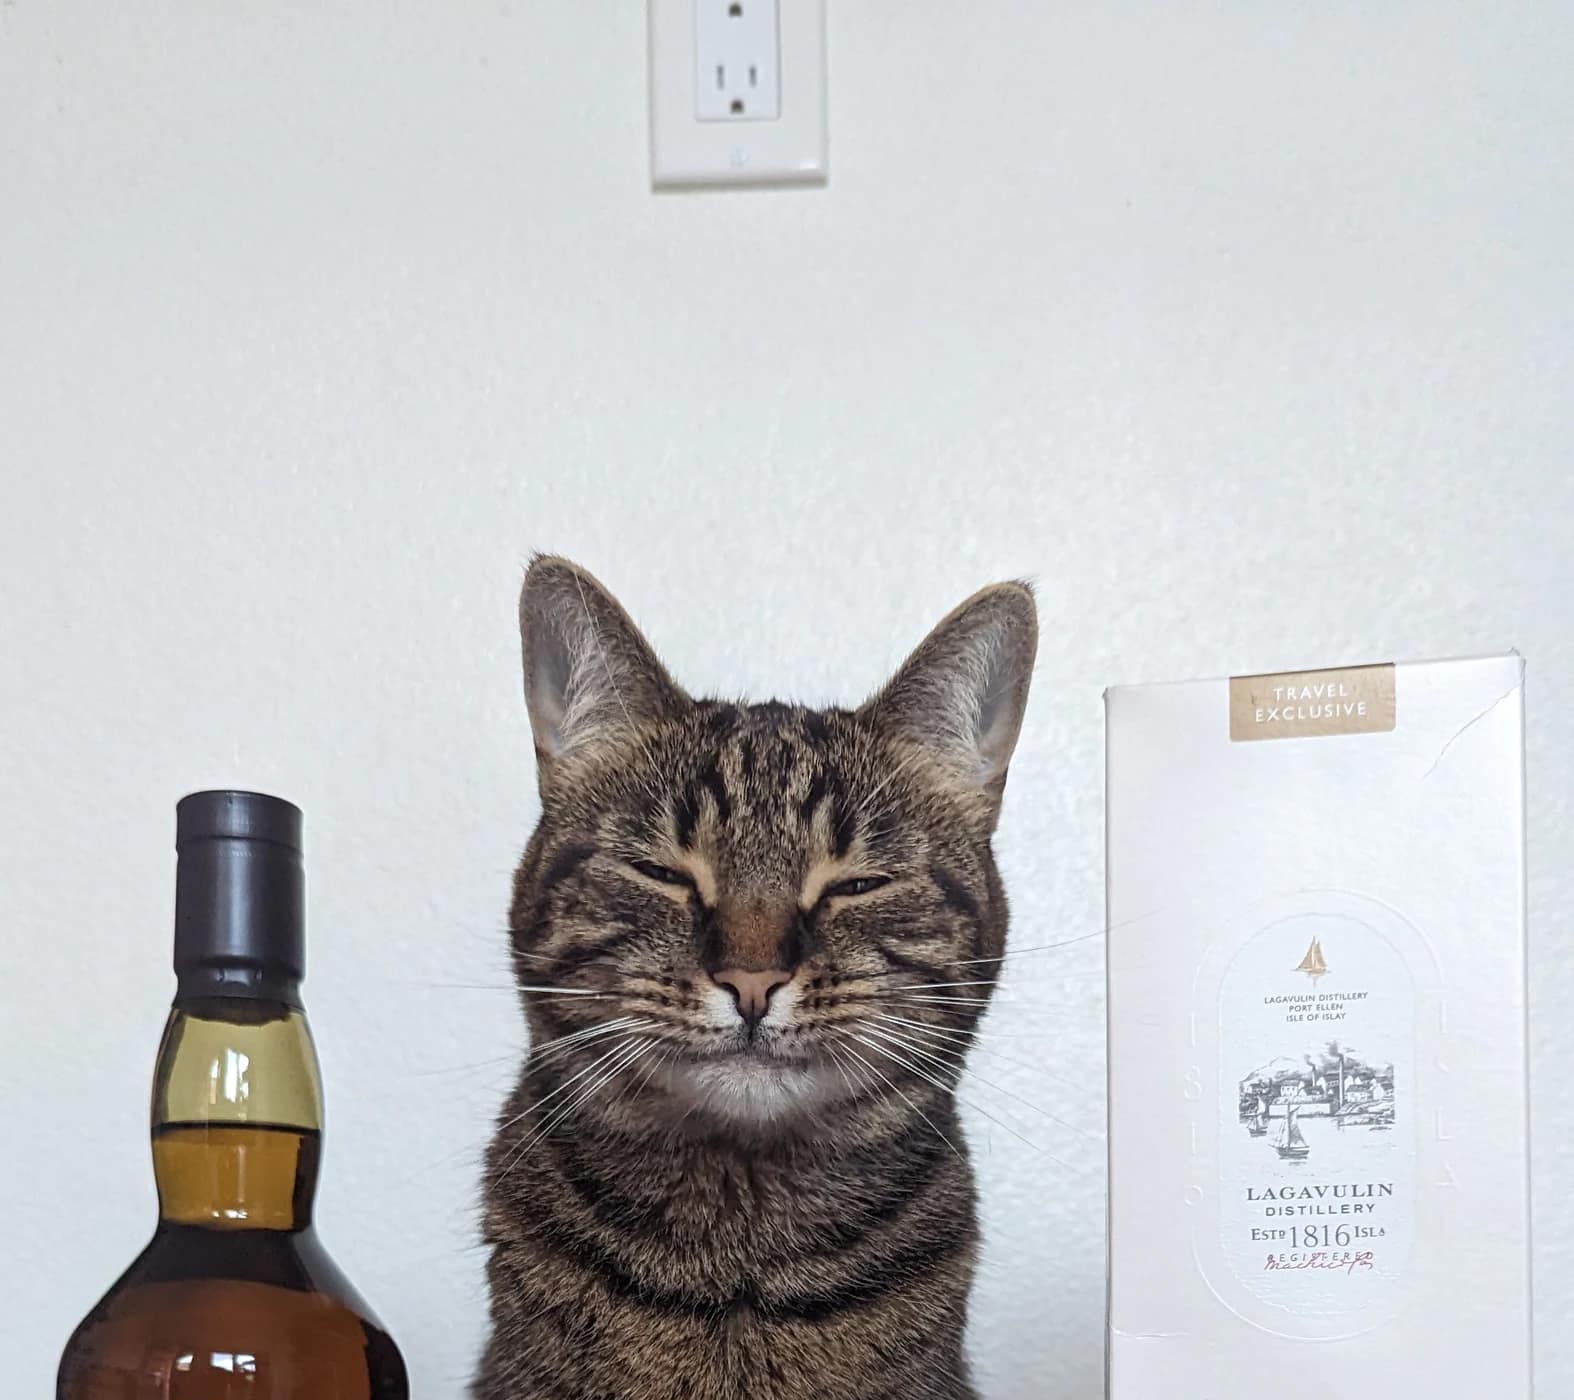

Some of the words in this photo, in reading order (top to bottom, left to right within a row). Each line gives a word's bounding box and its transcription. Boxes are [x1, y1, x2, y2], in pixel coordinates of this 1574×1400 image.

[1273, 684, 1348, 700] TRAVEL
[1255, 702, 1368, 722] EXCLUSIVE
[1264, 994, 1315, 1004] LAGAVULIN
[1319, 992, 1368, 1001] DISTILLERY
[1289, 1004, 1312, 1012] PORT
[1316, 1003, 1343, 1011] ELLEN
[1286, 1014, 1304, 1022] ISLE
[1306, 1013, 1319, 1021] OF
[1322, 1012, 1346, 1020] ISLAY
[1246, 1183, 1393, 1201] LAGAVULIN
[1265, 1203, 1375, 1217] DISTILLERY
[1289, 1223, 1350, 1248] 1816
